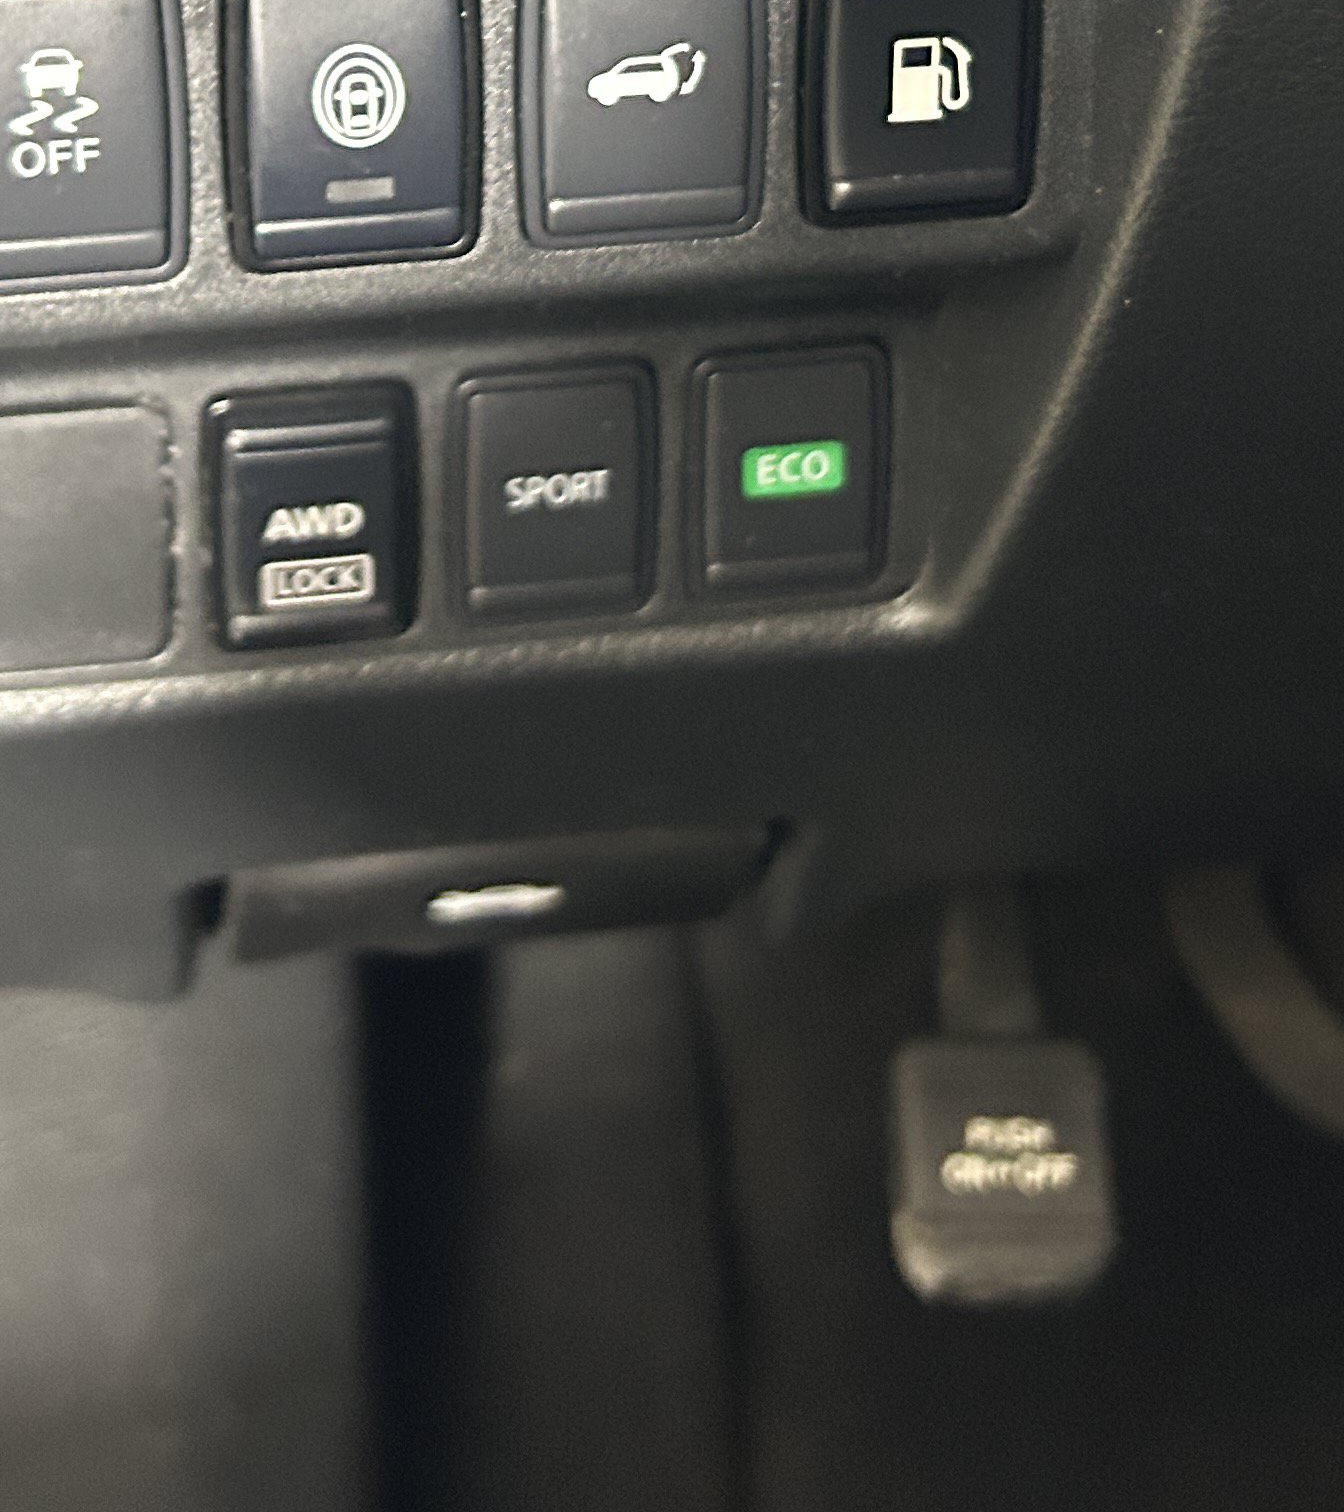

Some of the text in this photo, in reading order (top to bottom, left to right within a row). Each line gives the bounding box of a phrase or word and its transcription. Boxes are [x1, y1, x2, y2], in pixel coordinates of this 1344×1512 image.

[11, 137, 100, 178] OFF
[755, 449, 831, 487] ECO
[504, 468, 610, 513] SPORT
[260, 501, 365, 543] AWD
[277, 564, 364, 595] LOCK
